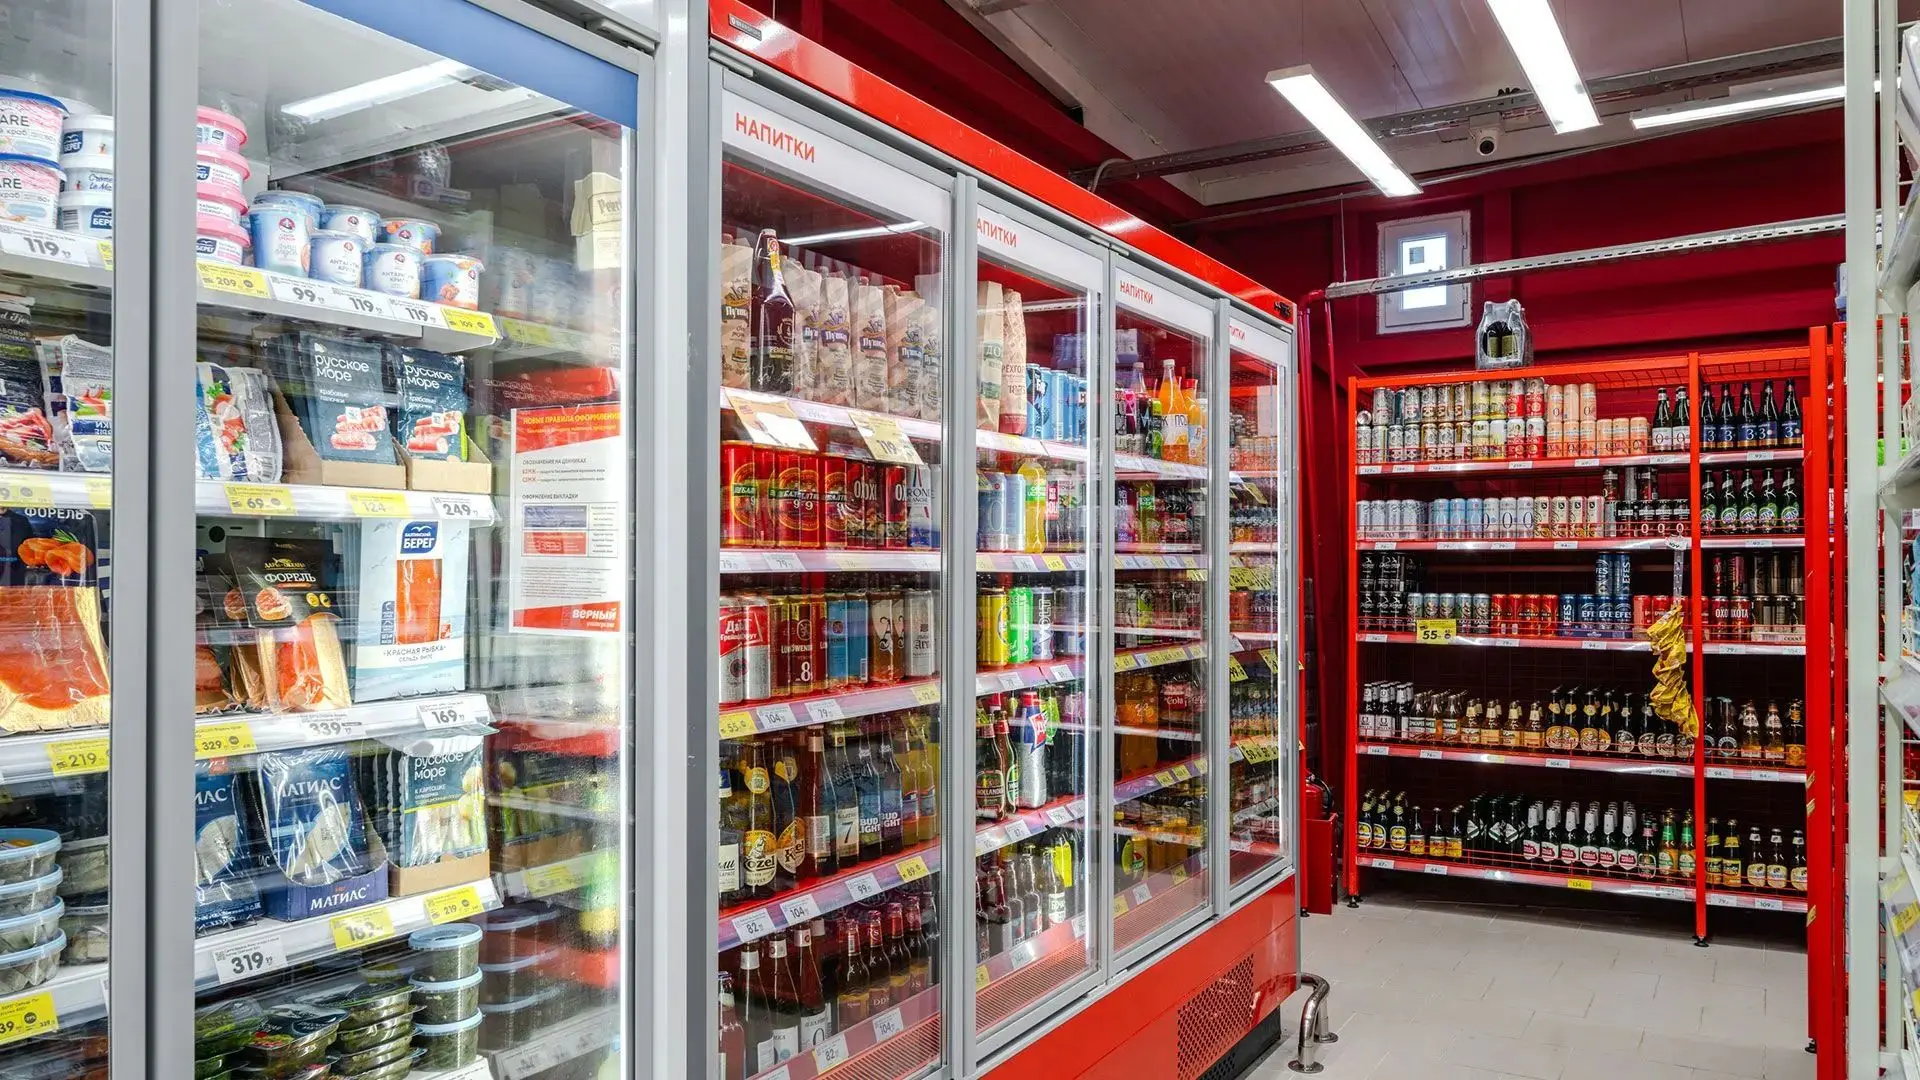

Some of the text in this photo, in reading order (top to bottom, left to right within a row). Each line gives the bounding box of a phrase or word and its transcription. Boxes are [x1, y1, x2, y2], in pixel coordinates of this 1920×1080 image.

[736, 112, 816, 162] НАПИТКИ
[976, 218, 1016, 248] АПИТКИ
[23, 237, 59, 256] 119
[216, 276, 236, 288] 209
[292, 286, 316, 302] 99
[1120, 280, 1153, 305] НАПИТКИ
[350, 297, 374, 312] 119
[405, 307, 428, 322] 119
[315, 353, 370, 374] русское
[316, 368, 352, 382] море
[405, 364, 454, 382] русское
[406, 376, 440, 390] море
[246, 498, 264, 510] 69
[443, 504, 471, 517] 249
[805, 500, 814, 510] 9
[24, 508, 85, 520] ФОРЕЛЬ
[404, 536, 435, 550] БЕРЕГ
[264, 572, 316, 583] ФОРЕЛЬ
[1422, 630, 1438, 640] 55
[800, 661, 811, 682] 8
[431, 708, 458, 724] 169
[765, 712, 780, 723] 104
[818, 708, 828, 718] 79
[309, 722, 342, 736] 339
[729, 722, 738, 732] 55
[202, 740, 222, 751] 329
[68, 752, 96, 768] 219
[414, 752, 464, 770] русское
[414, 766, 446, 781] море
[860, 818, 878, 826] BUD
[838, 821, 854, 844] 7
[907, 868, 916, 876] 89
[310, 887, 367, 911] МАТИАС
[444, 904, 457, 915] 219
[790, 906, 805, 918] 104
[746, 922, 760, 934] 82
[232, 952, 264, 974] 319
[825, 1048, 835, 1061] 82
